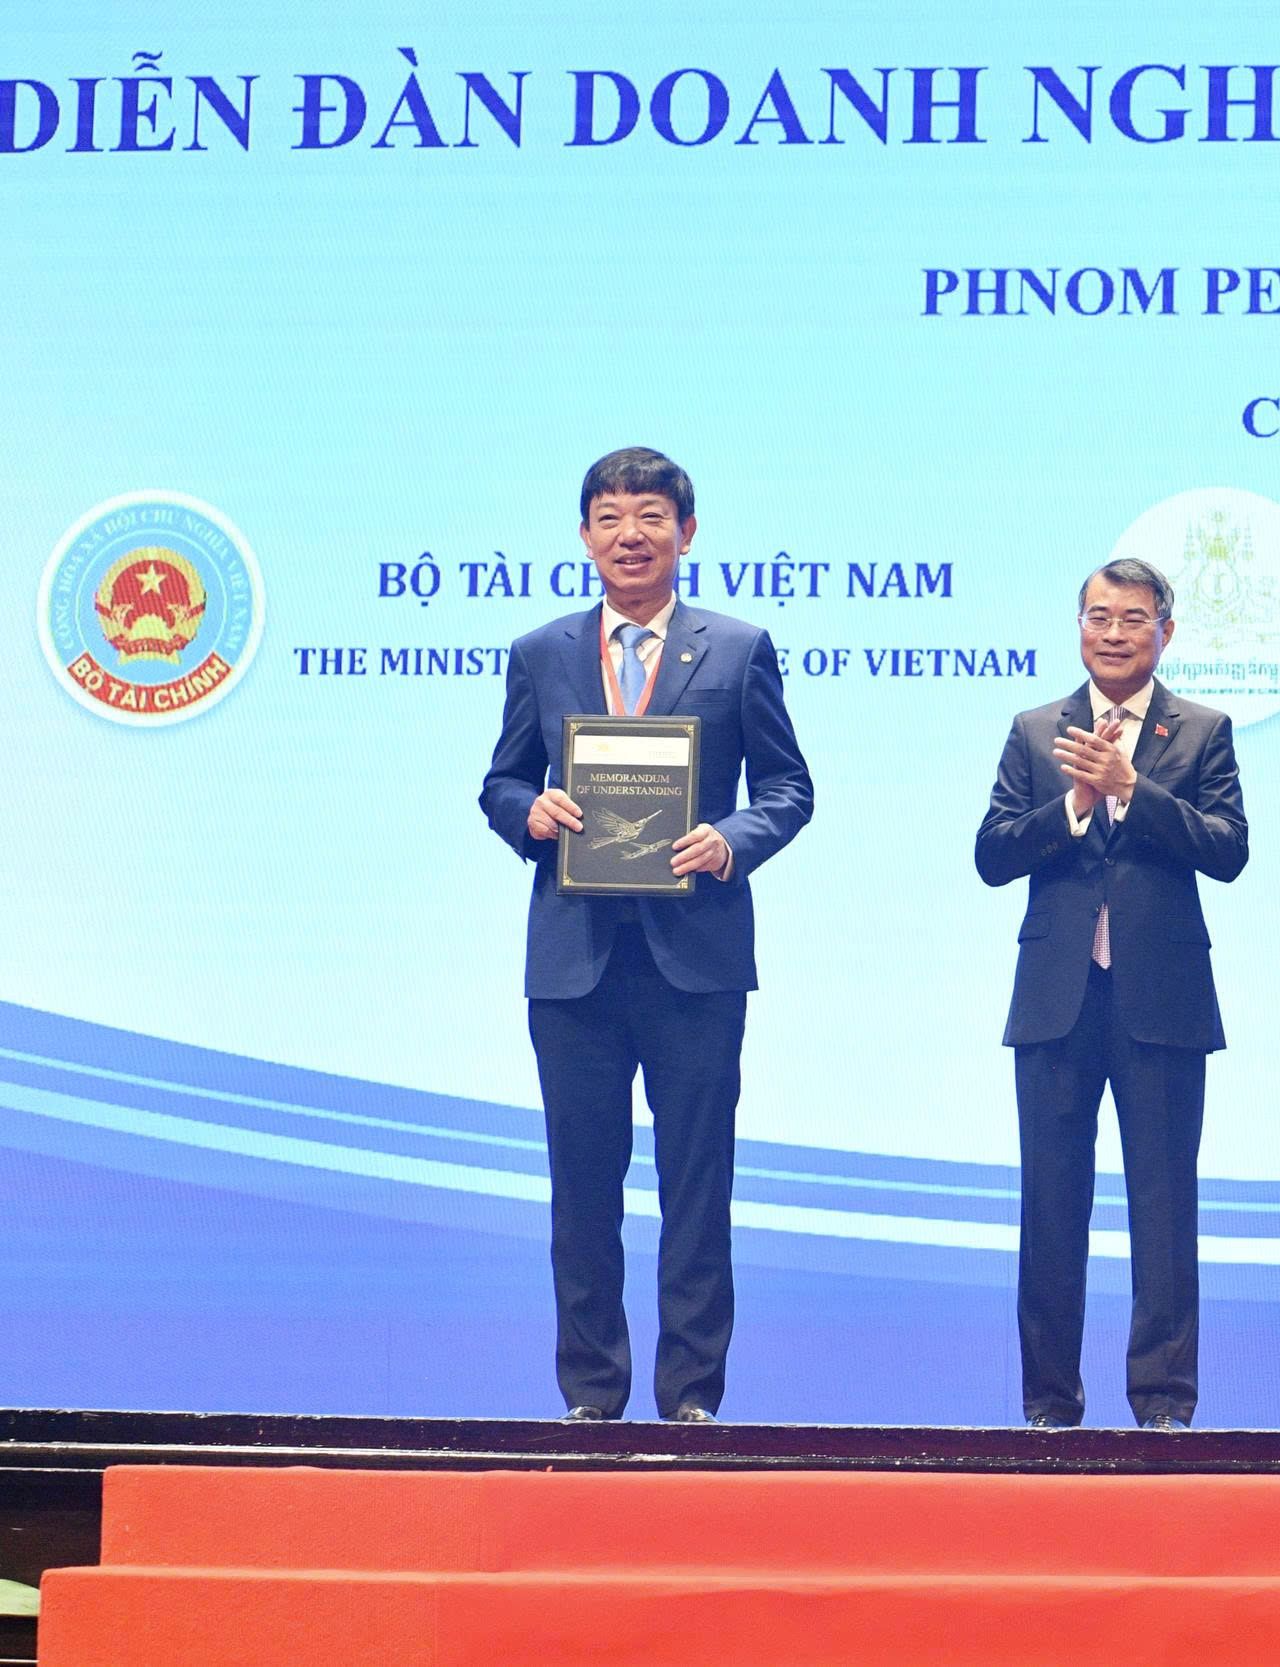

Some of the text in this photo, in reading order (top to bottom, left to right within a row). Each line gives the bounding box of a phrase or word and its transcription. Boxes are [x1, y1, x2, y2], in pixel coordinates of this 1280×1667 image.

[0, 50, 261, 154] DIỄN
[291, 47, 533, 149] ĐÀN
[564, 67, 989, 147] DOANH
[921, 268, 1179, 316] PHNOM
[378, 551, 953, 607] BỘ TÀI CHH VIỆT NAM
[293, 648, 368, 676] THE
[380, 648, 508, 676] MINIST
[802, 648, 851, 677] OF
[864, 648, 1037, 677] VIETNAM
[576, 785, 682, 796] OF UNDERSTANDING
[589, 773, 670, 784] MEMORANDUM
